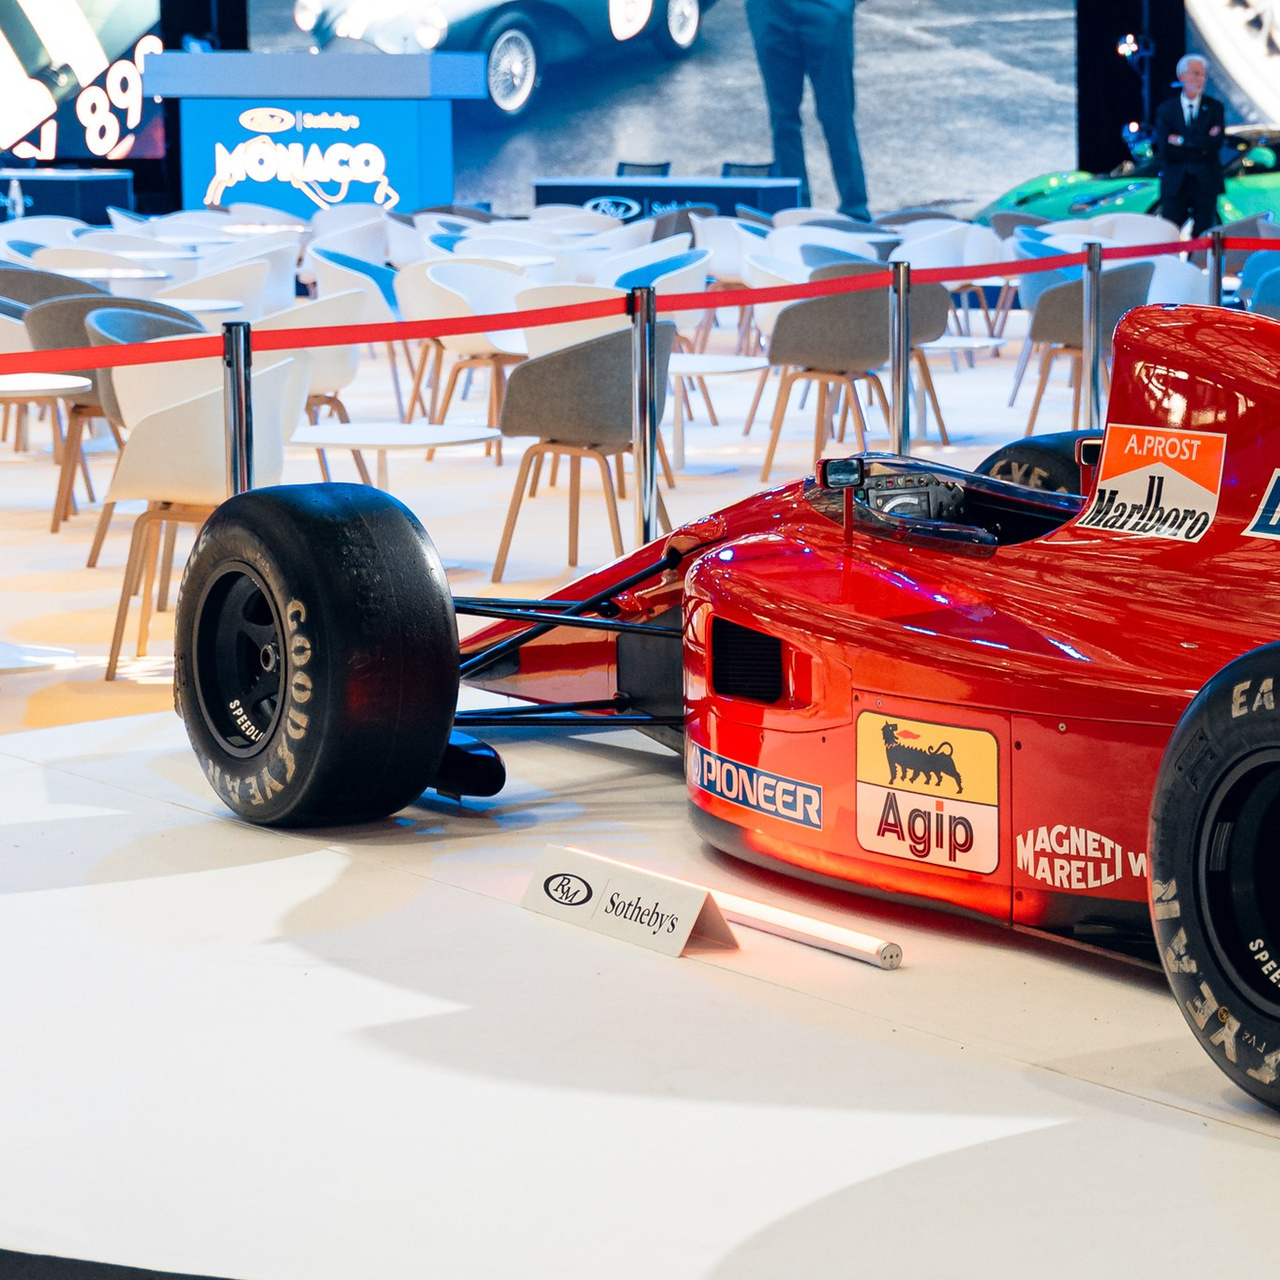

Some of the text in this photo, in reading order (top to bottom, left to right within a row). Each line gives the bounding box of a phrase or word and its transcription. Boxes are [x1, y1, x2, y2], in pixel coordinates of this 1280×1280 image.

[215, 142, 386, 183] MONACO
[1124, 433, 1201, 461] A.PROST
[1079, 475, 1210, 540] Marlboro
[703, 753, 821, 826] PIONEER
[876, 791, 975, 862] Agip
[1016, 824, 1122, 870] MAGNETI
[1016, 842, 1122, 890] MARELLI
[604, 891, 680, 934] Sotheby's
